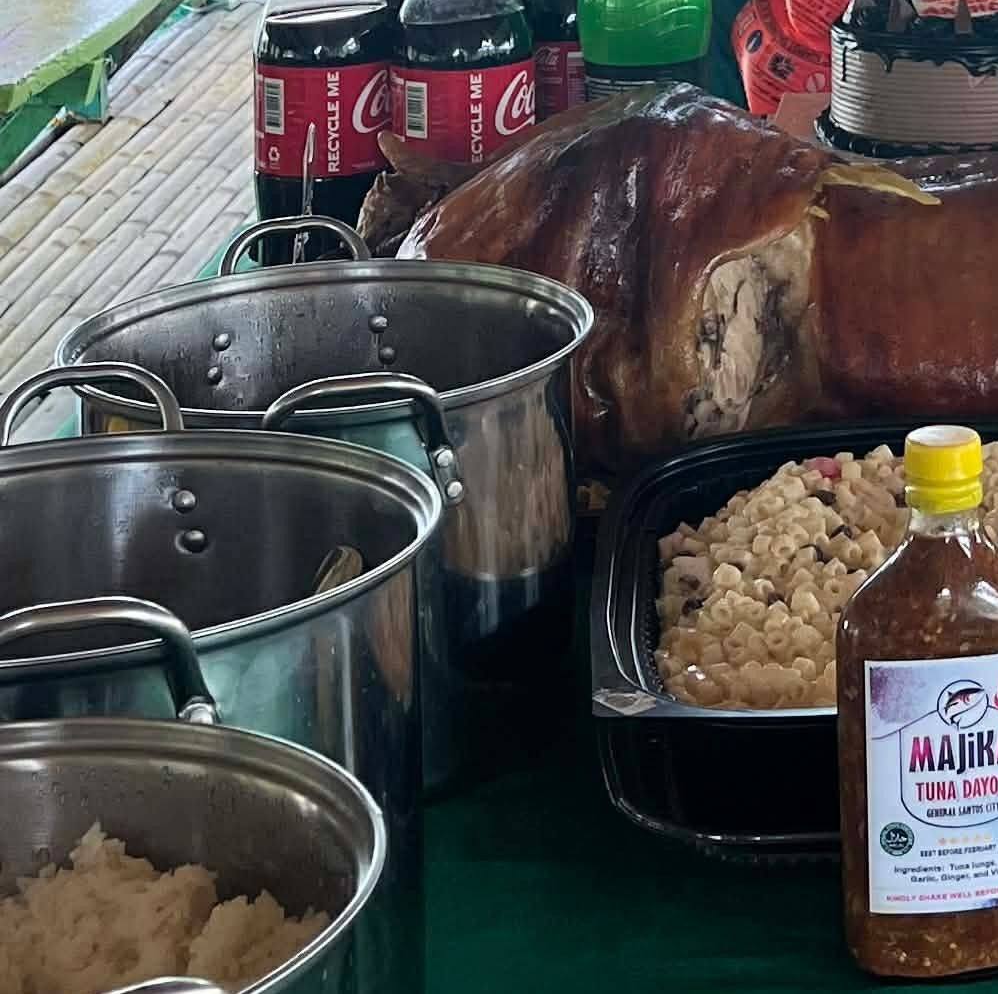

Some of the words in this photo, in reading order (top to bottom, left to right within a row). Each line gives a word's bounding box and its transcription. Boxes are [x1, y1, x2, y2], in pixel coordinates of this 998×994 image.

[327, 70, 340, 97] ME
[470, 73, 483, 100] ME
[327, 100, 340, 173] RECYCLE
[470, 104, 483, 164] ECYCLE
[915, 780, 957, 802] TUNA
[926, 807, 957, 818] GENERAL
[958, 804, 984, 817] SANTOS
[973, 869, 990, 880] and
[949, 890, 973, 901] WELL
